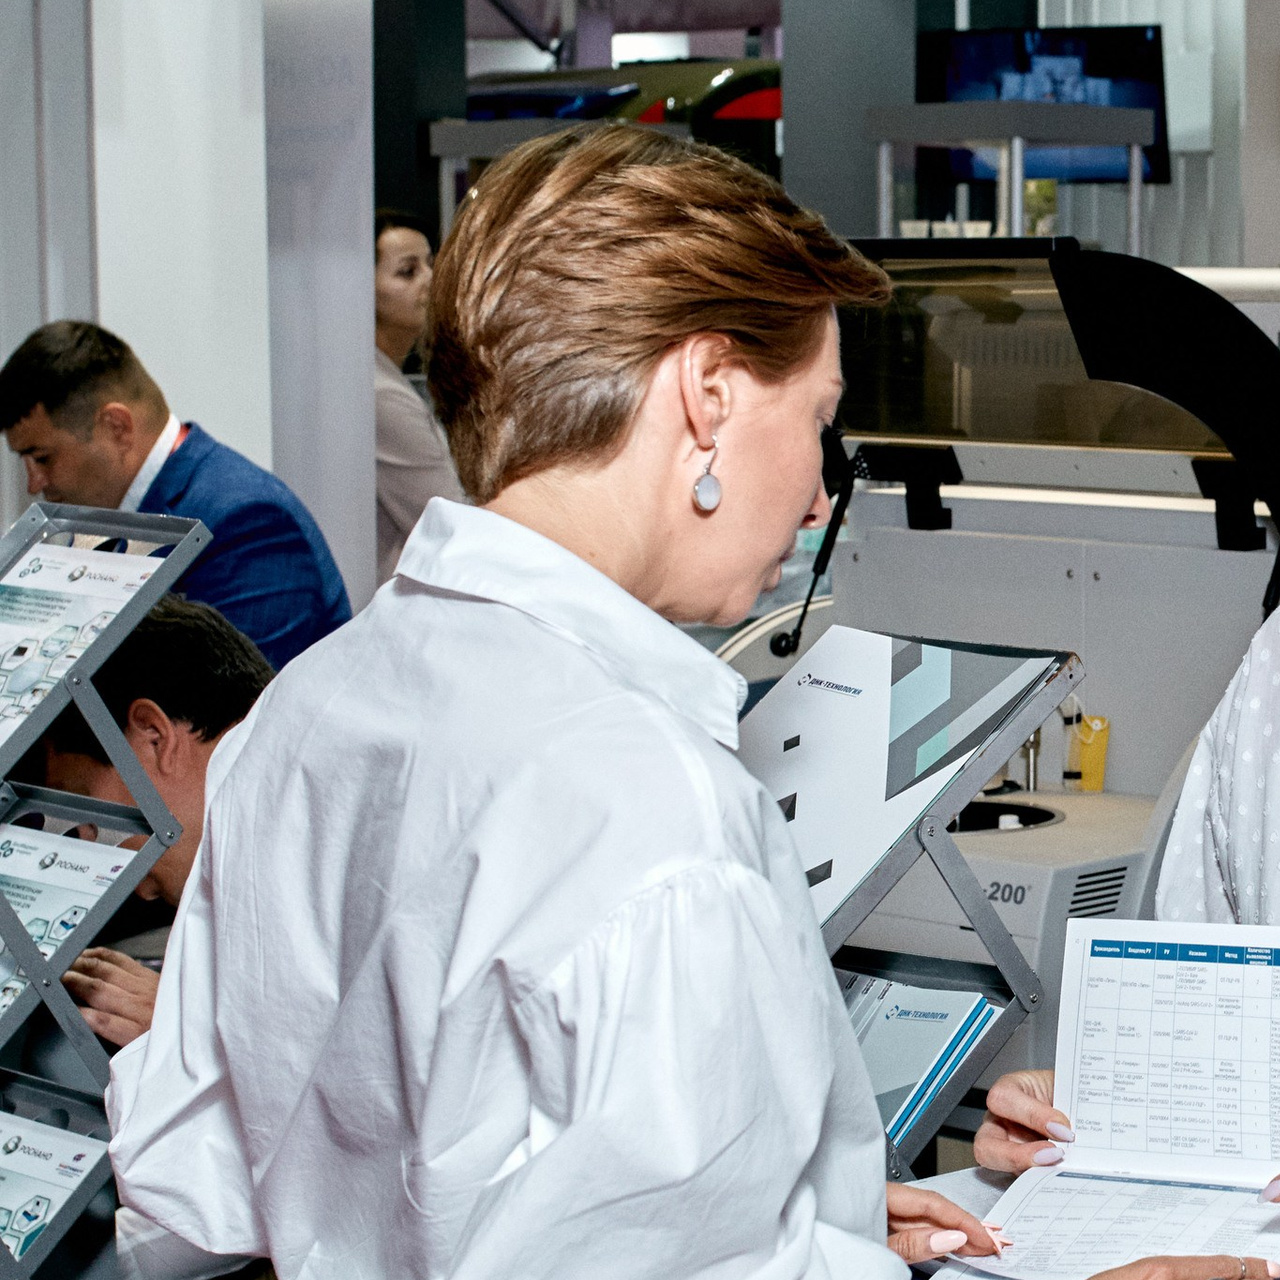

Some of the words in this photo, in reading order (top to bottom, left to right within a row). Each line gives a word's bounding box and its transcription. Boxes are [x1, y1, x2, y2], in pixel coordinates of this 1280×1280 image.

[808, 678, 863, 695] ДНК-ТЕХНОЛОГИЯ
[55, 859, 90, 874] РОСНАНО
[896, 1009, 949, 1020] ДНК-ТЕХНОЛОГИЯ
